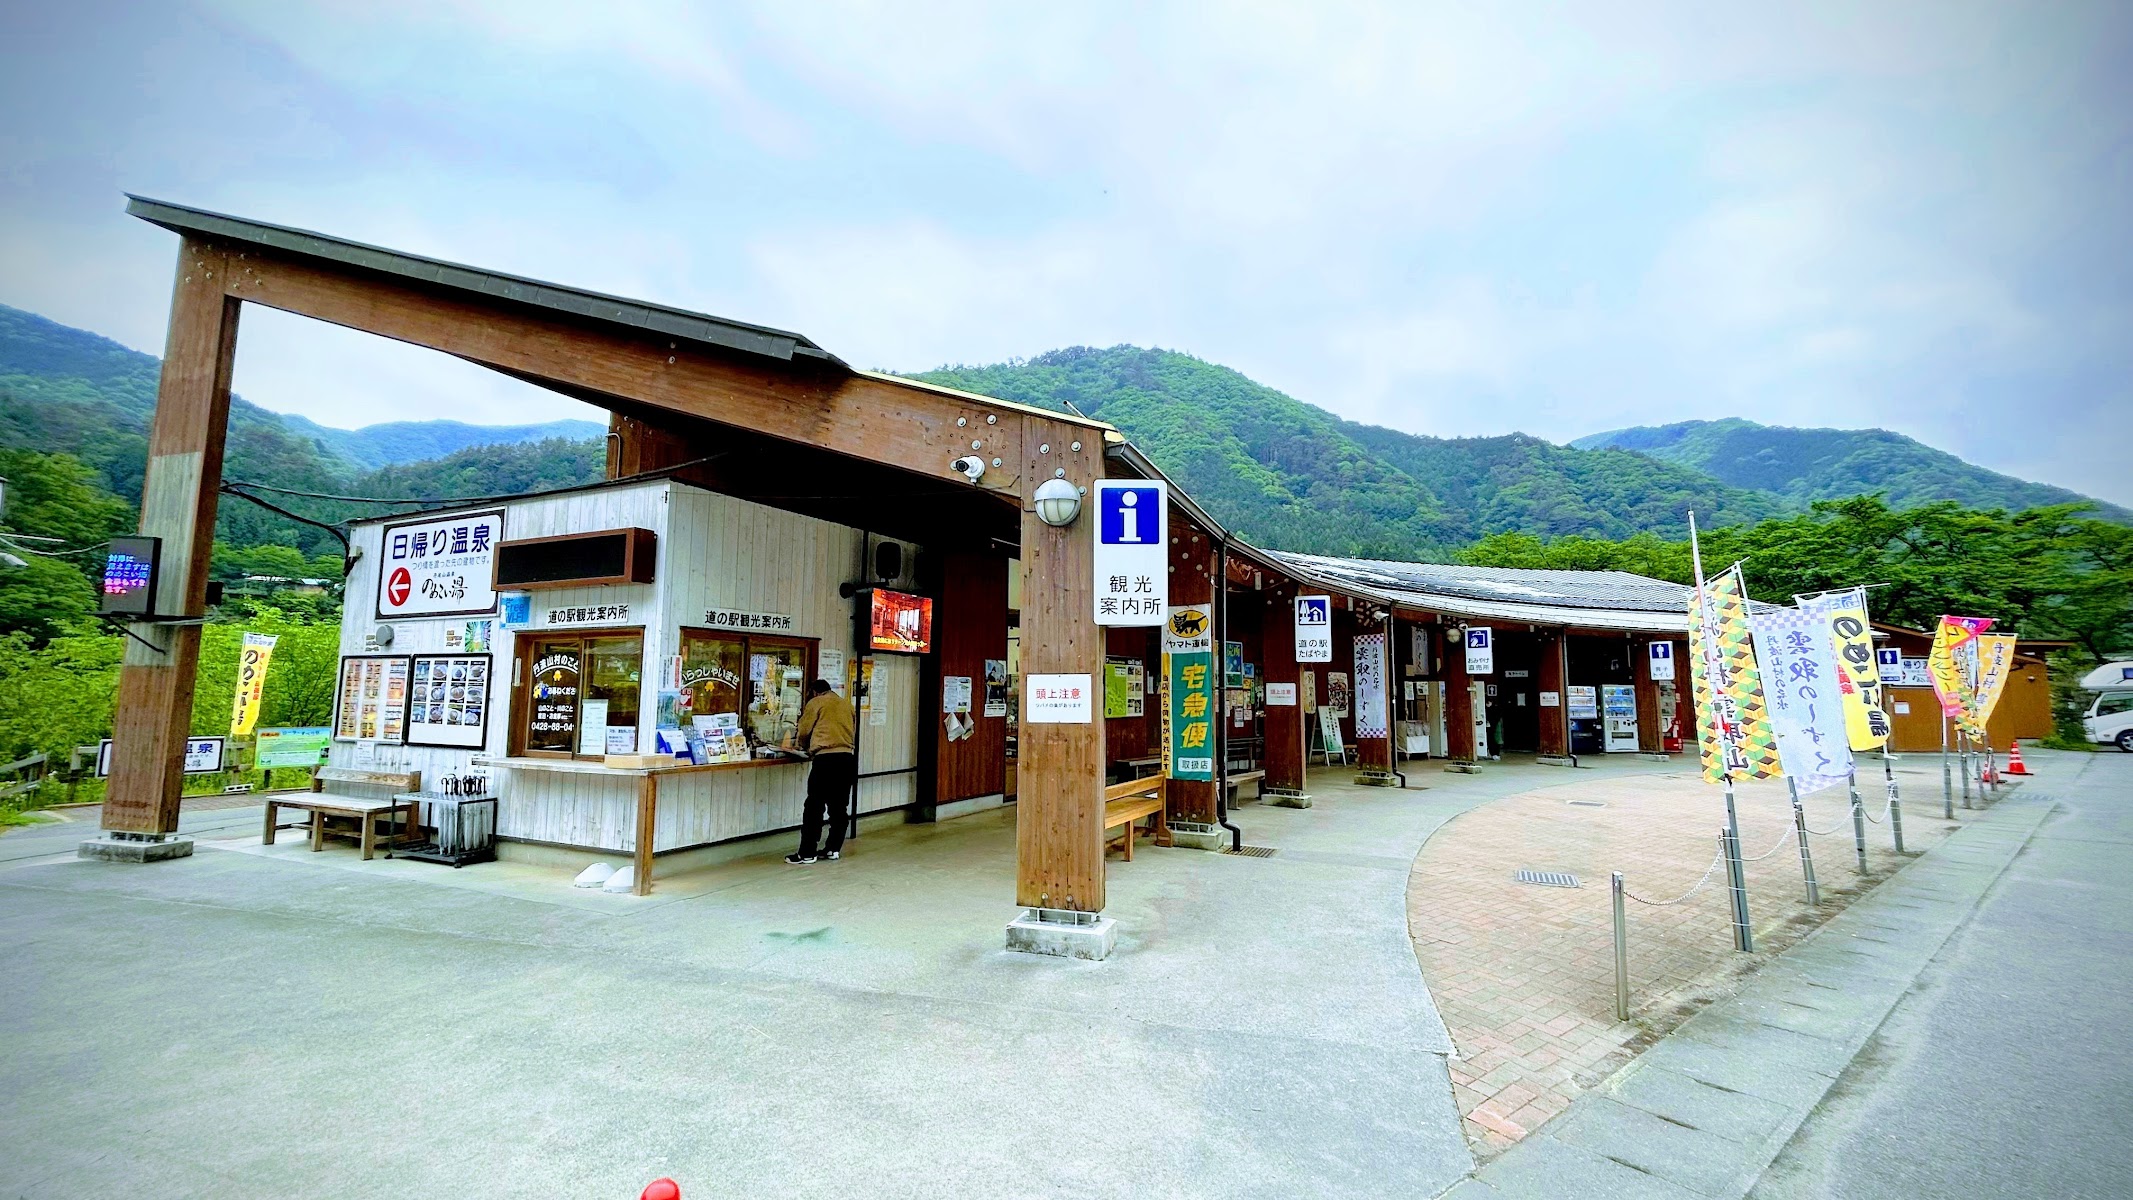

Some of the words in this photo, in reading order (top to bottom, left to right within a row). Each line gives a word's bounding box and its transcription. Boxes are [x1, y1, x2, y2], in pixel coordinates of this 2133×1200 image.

[392, 523, 490, 560] 日帰り温泉
[1109, 575, 1152, 593] 観光
[505, 601, 525, 612] Free
[547, 604, 629, 624] 道の駅観光案内所
[1100, 597, 1161, 616] 案内所
[704, 610, 791, 629] 道の駅観光案内所
[1298, 639, 1328, 648] 道の駅
[1298, 649, 1328, 658] たばやま
[1035, 687, 1082, 700] 頭上注意
[1356, 646, 1371, 727] 雲取のしずく
[1180, 662, 1209, 749] 宅急便
[1181, 759, 1209, 770] 取扱店
